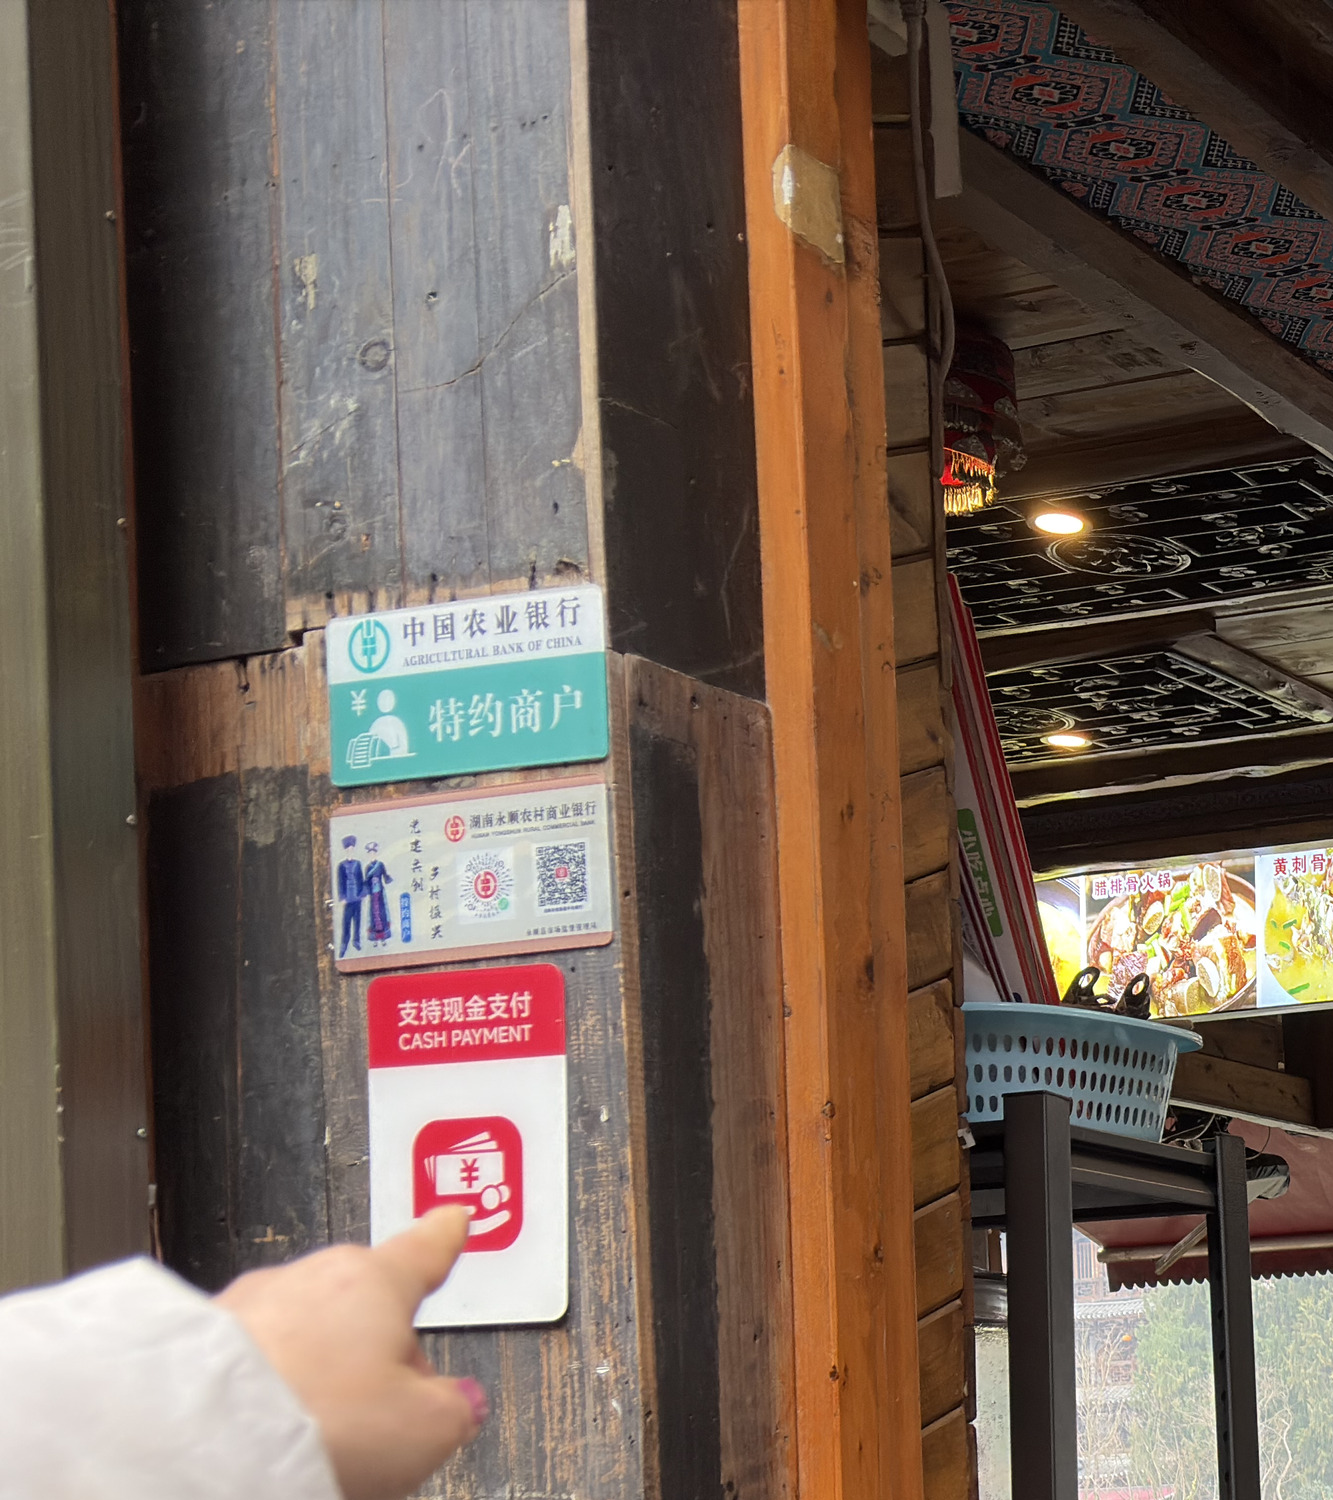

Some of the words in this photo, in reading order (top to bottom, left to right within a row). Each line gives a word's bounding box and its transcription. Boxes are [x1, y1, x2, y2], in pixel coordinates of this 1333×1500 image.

[402, 597, 581, 646] 中国农业银行
[403, 645, 489, 667] AGRICULTURAL
[493, 640, 524, 658] BANK
[528, 639, 543, 652] OF
[546, 635, 582, 650] CHINA
[429, 685, 583, 743] 特约商户
[469, 801, 597, 829] 湖南永顺农村商业银行
[1273, 855, 1327, 877] 黄刺骨
[1094, 874, 1172, 899] 腊排骨火锅
[398, 991, 532, 1027] 支持现金支付
[399, 1028, 448, 1051] CASH
[452, 1024, 532, 1047] PAYMENT
